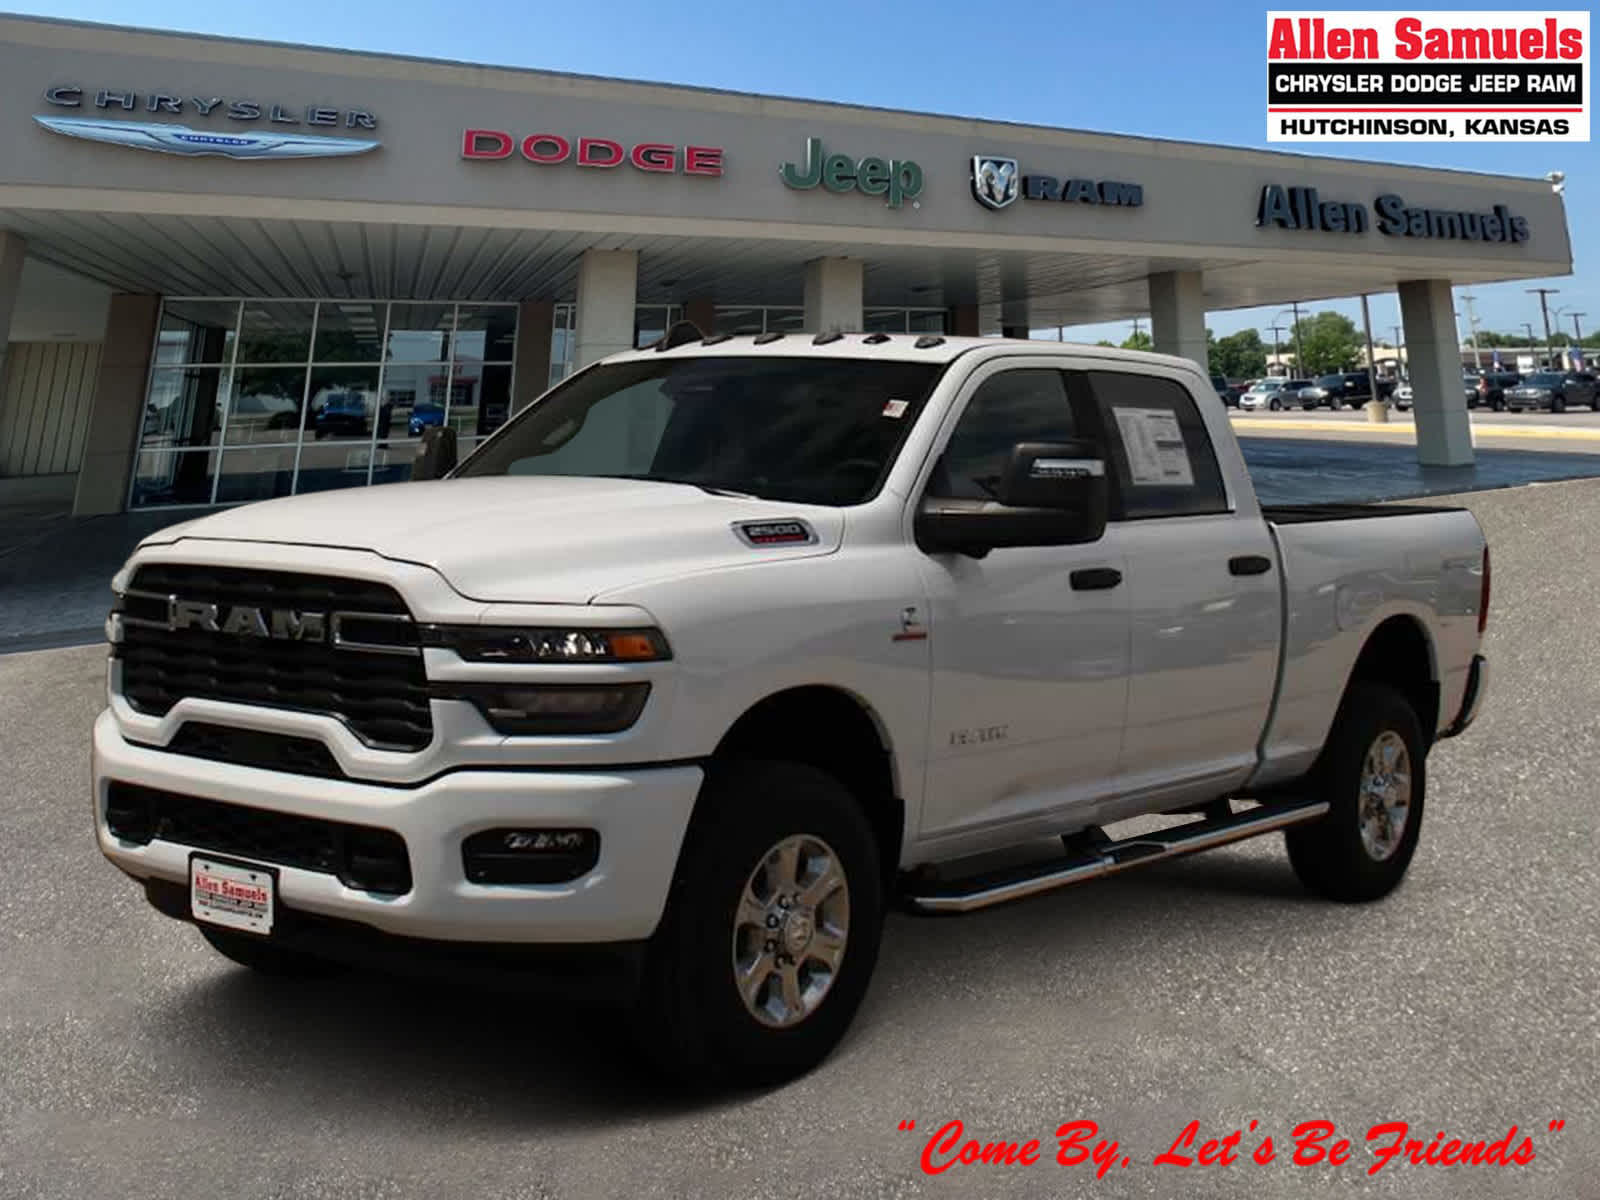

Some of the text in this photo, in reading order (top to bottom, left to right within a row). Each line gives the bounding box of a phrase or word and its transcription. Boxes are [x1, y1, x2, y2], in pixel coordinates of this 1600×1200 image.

[44, 86, 379, 129] CHRYSLER
[462, 128, 725, 177] DODGE
[779, 136, 923, 209] Jeep
[1023, 175, 1143, 207] RAM
[1256, 184, 1530, 243] Allen Samuels
[168, 596, 326, 642] RAM
